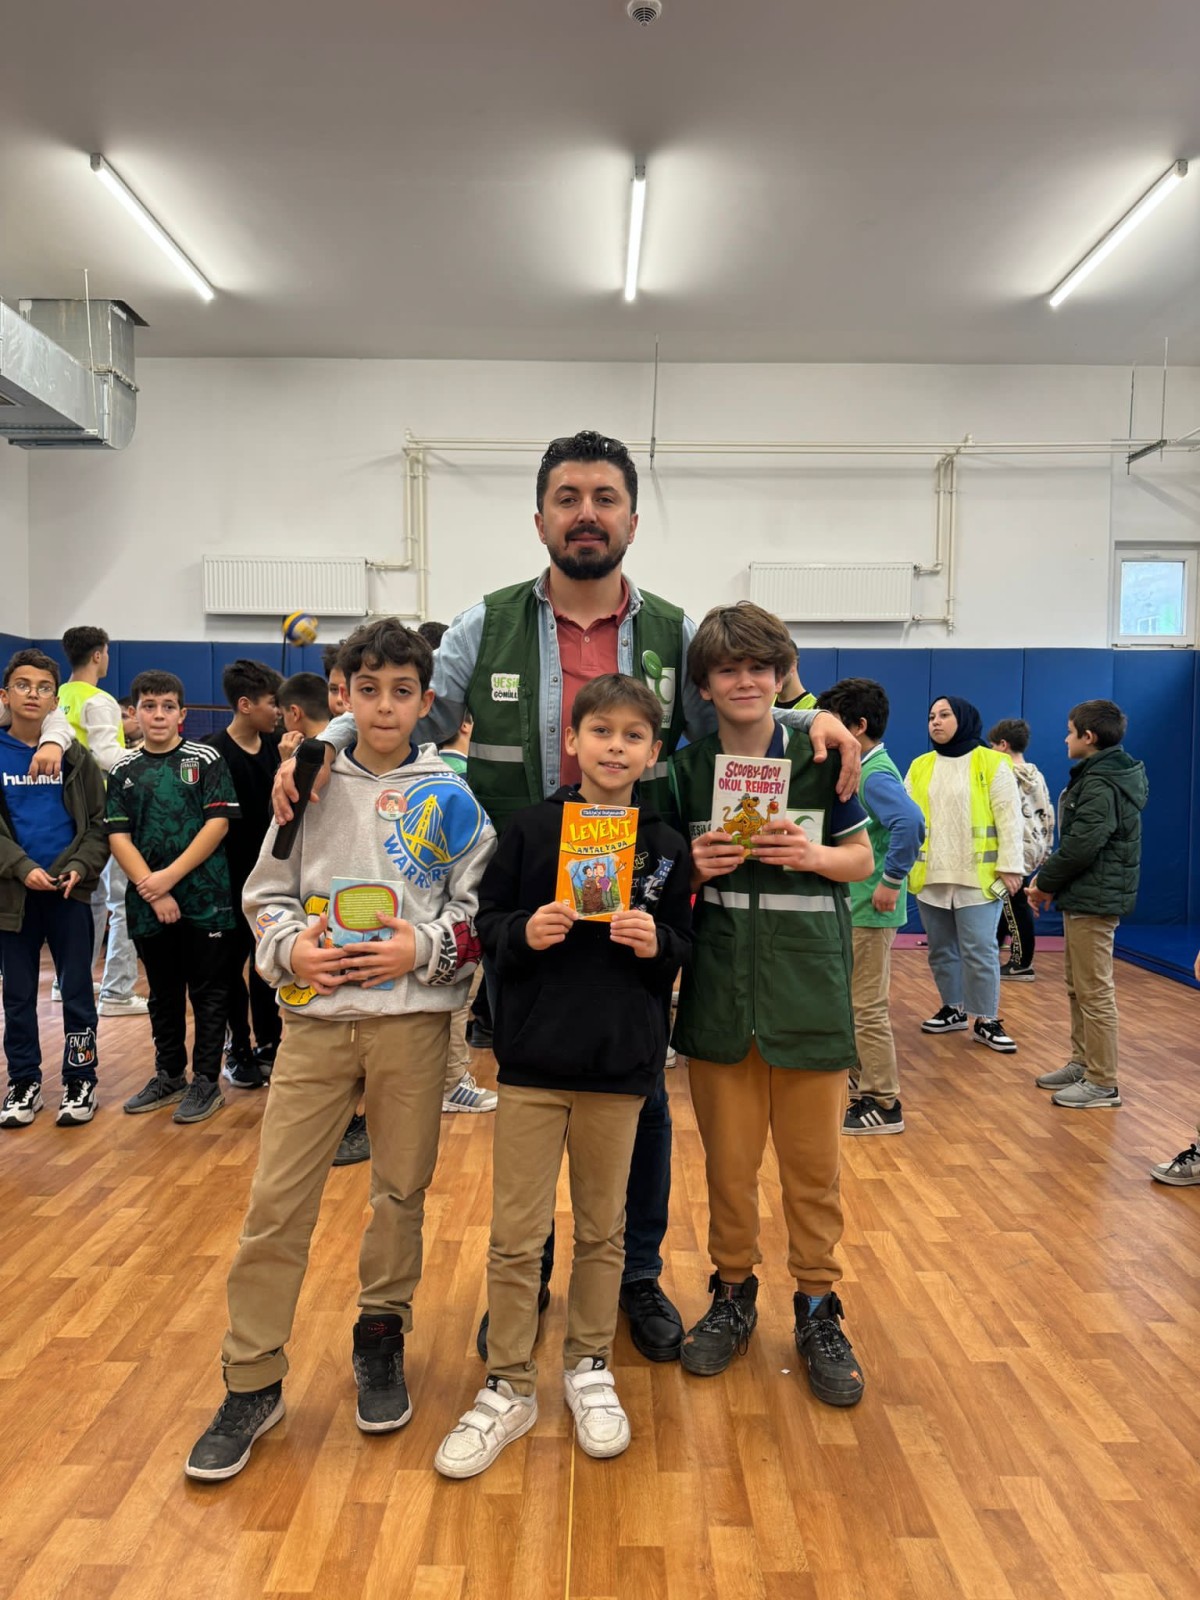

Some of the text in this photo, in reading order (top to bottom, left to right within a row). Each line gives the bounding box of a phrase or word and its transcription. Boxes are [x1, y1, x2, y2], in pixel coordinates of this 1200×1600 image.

[718, 778, 786, 794] OKUL REHBERİ
[569, 817, 631, 842] LEVENT
